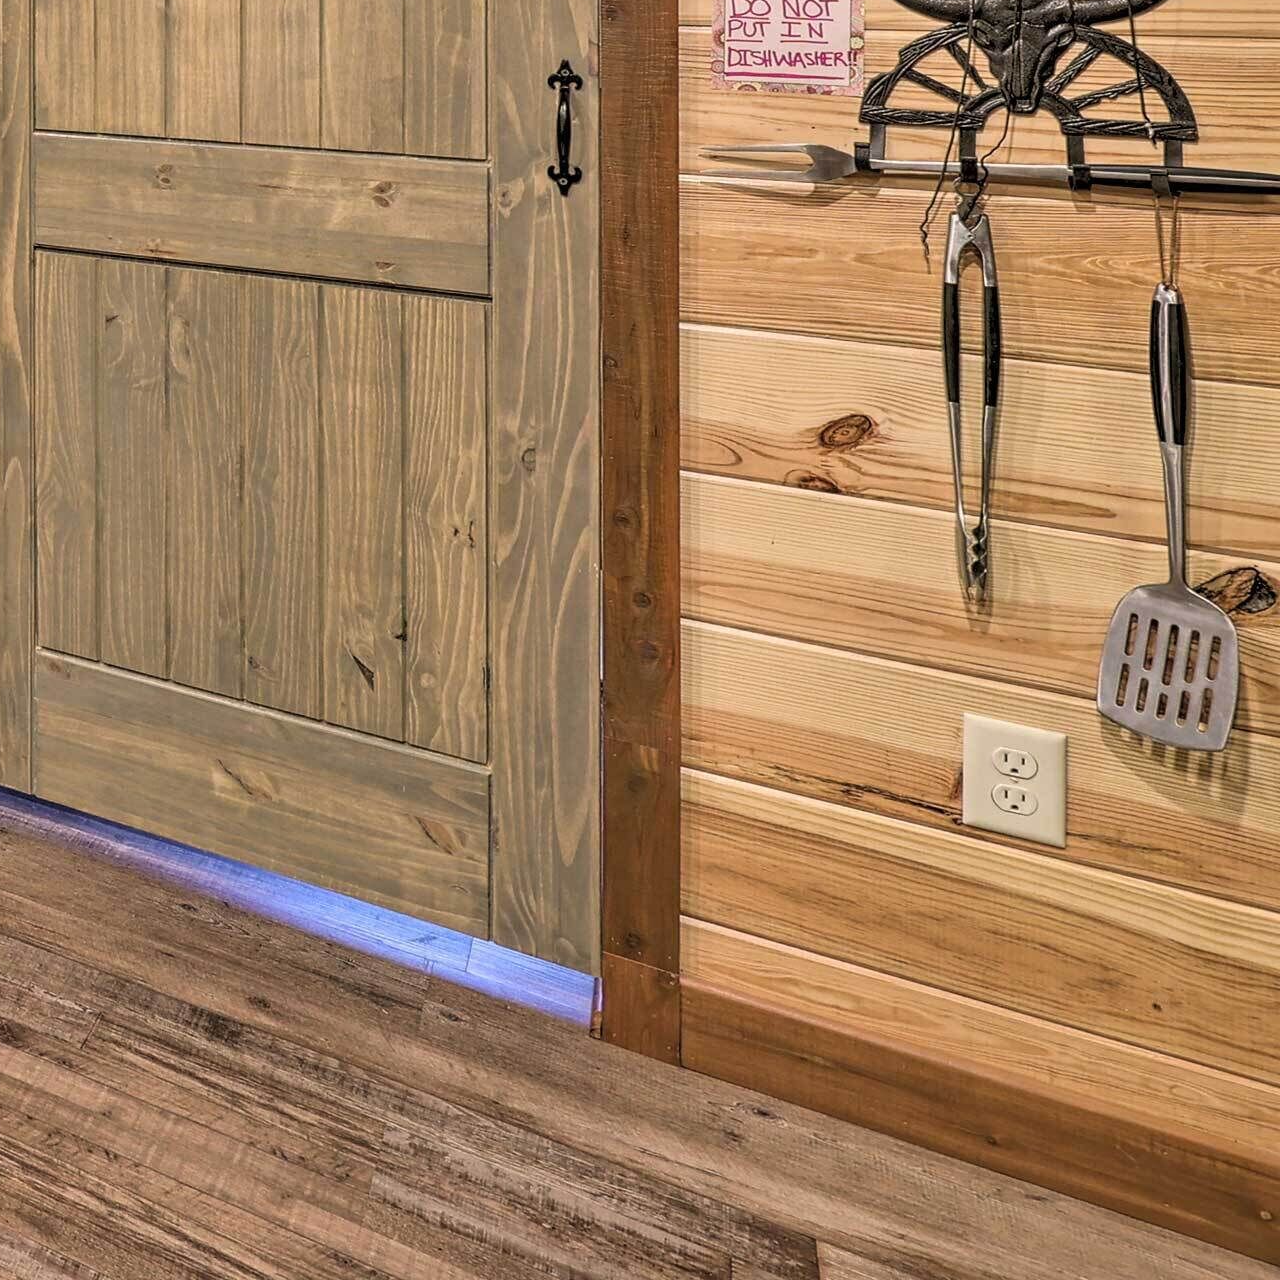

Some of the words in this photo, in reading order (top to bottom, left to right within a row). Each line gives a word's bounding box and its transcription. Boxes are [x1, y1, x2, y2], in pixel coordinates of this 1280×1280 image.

[728, 19, 771, 38] PUT
[780, 21, 824, 39] IN
[727, 47, 858, 68] DISHWASHER!!
